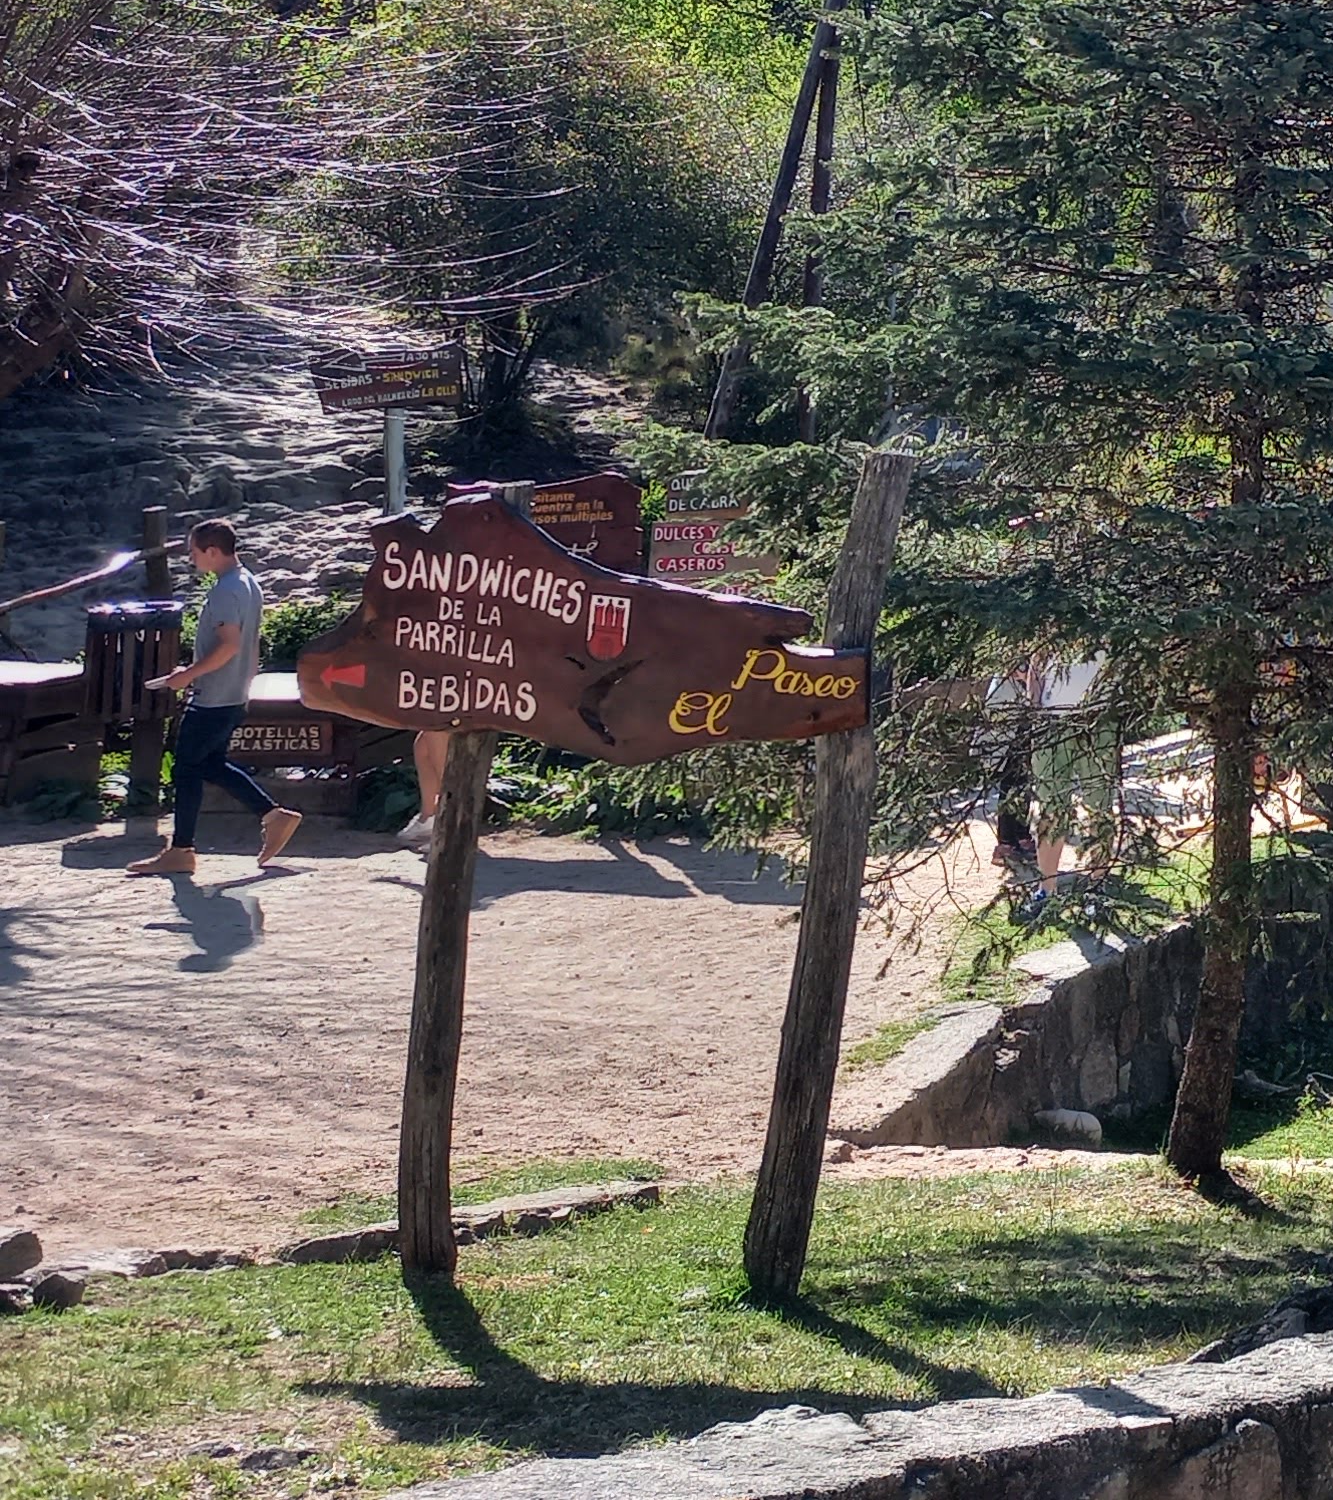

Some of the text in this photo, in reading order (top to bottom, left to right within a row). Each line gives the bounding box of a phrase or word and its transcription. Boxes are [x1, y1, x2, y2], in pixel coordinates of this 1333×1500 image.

[669, 499, 687, 511] DE
[654, 526, 719, 541] DULCES Y
[656, 558, 725, 572] CASEROS
[438, 596, 501, 626] DE LA
[731, 649, 861, 699] Paseo
[668, 692, 733, 736] El
[231, 726, 319, 739] BOTELLAS
[230, 739, 320, 751] PLASTICAS
